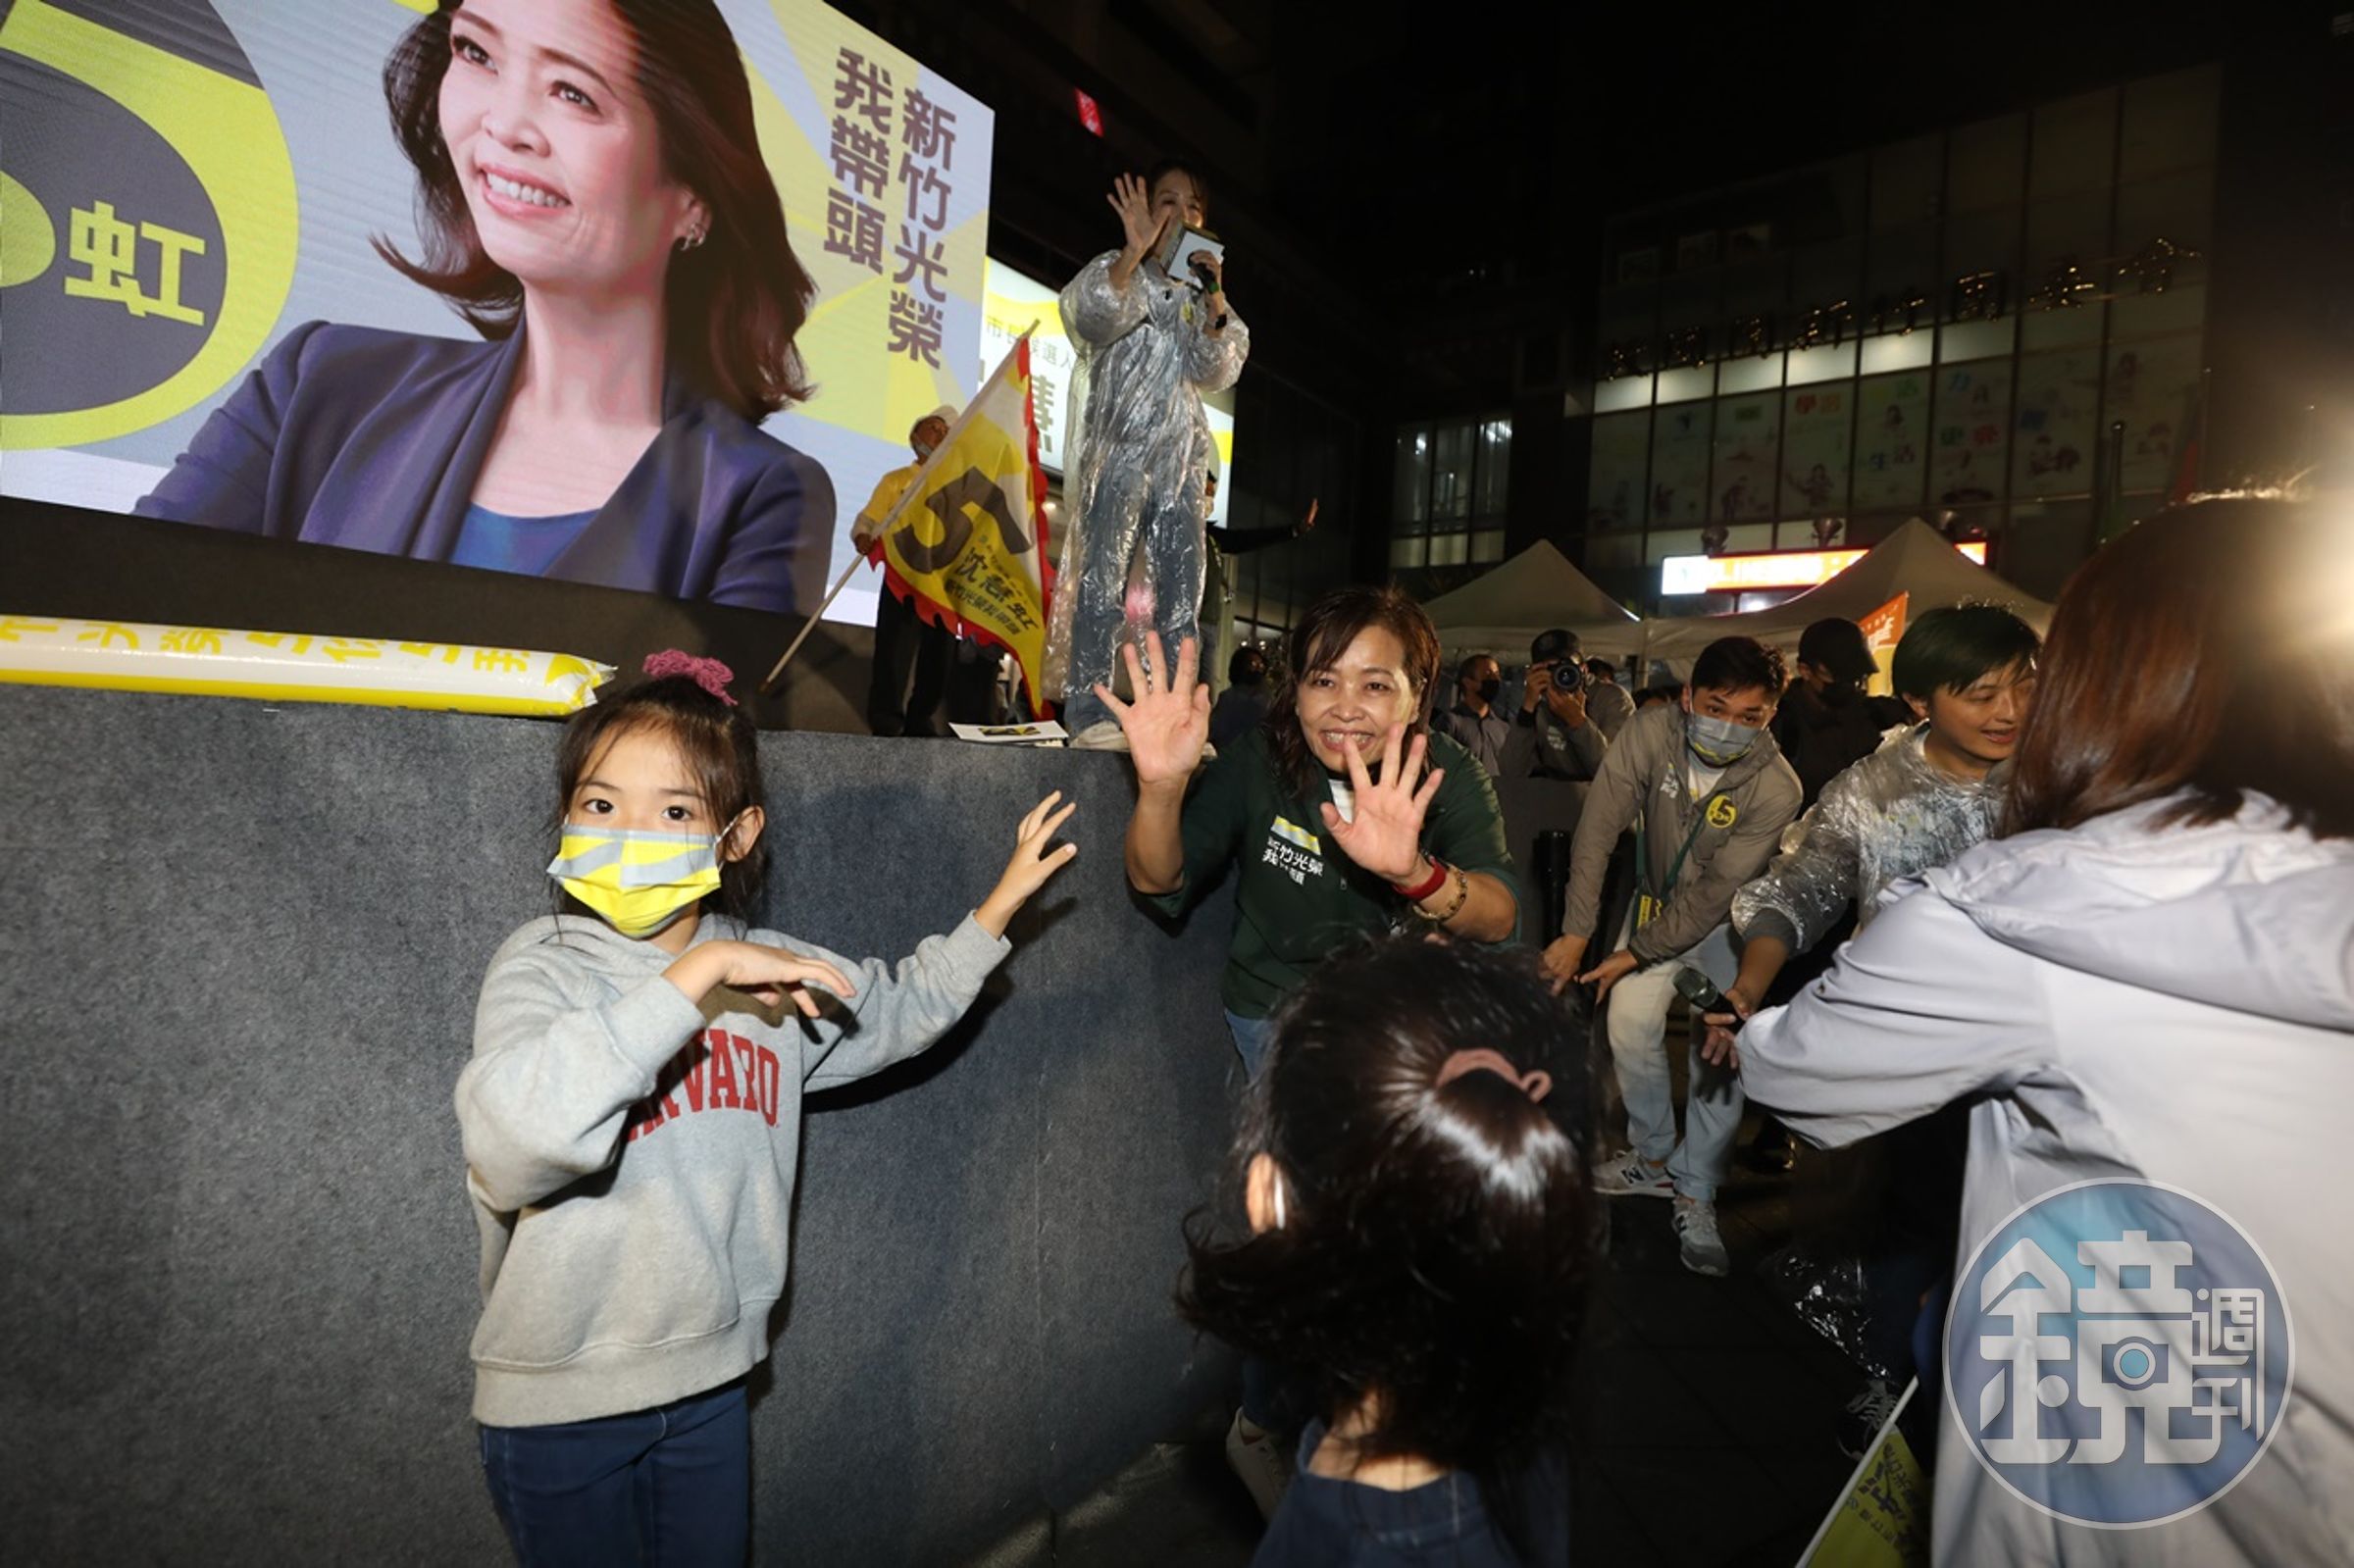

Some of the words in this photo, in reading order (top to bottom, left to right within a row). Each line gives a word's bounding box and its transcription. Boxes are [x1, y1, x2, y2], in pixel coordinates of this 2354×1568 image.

[824, 46, 894, 276] 我帶頭
[64, 199, 206, 327] 虹
[887, 86, 956, 370] 新竹光榮
[892, 465, 1033, 576] 5
[1261, 848, 1305, 885] 我頭
[628, 1028, 781, 1143] VARD
